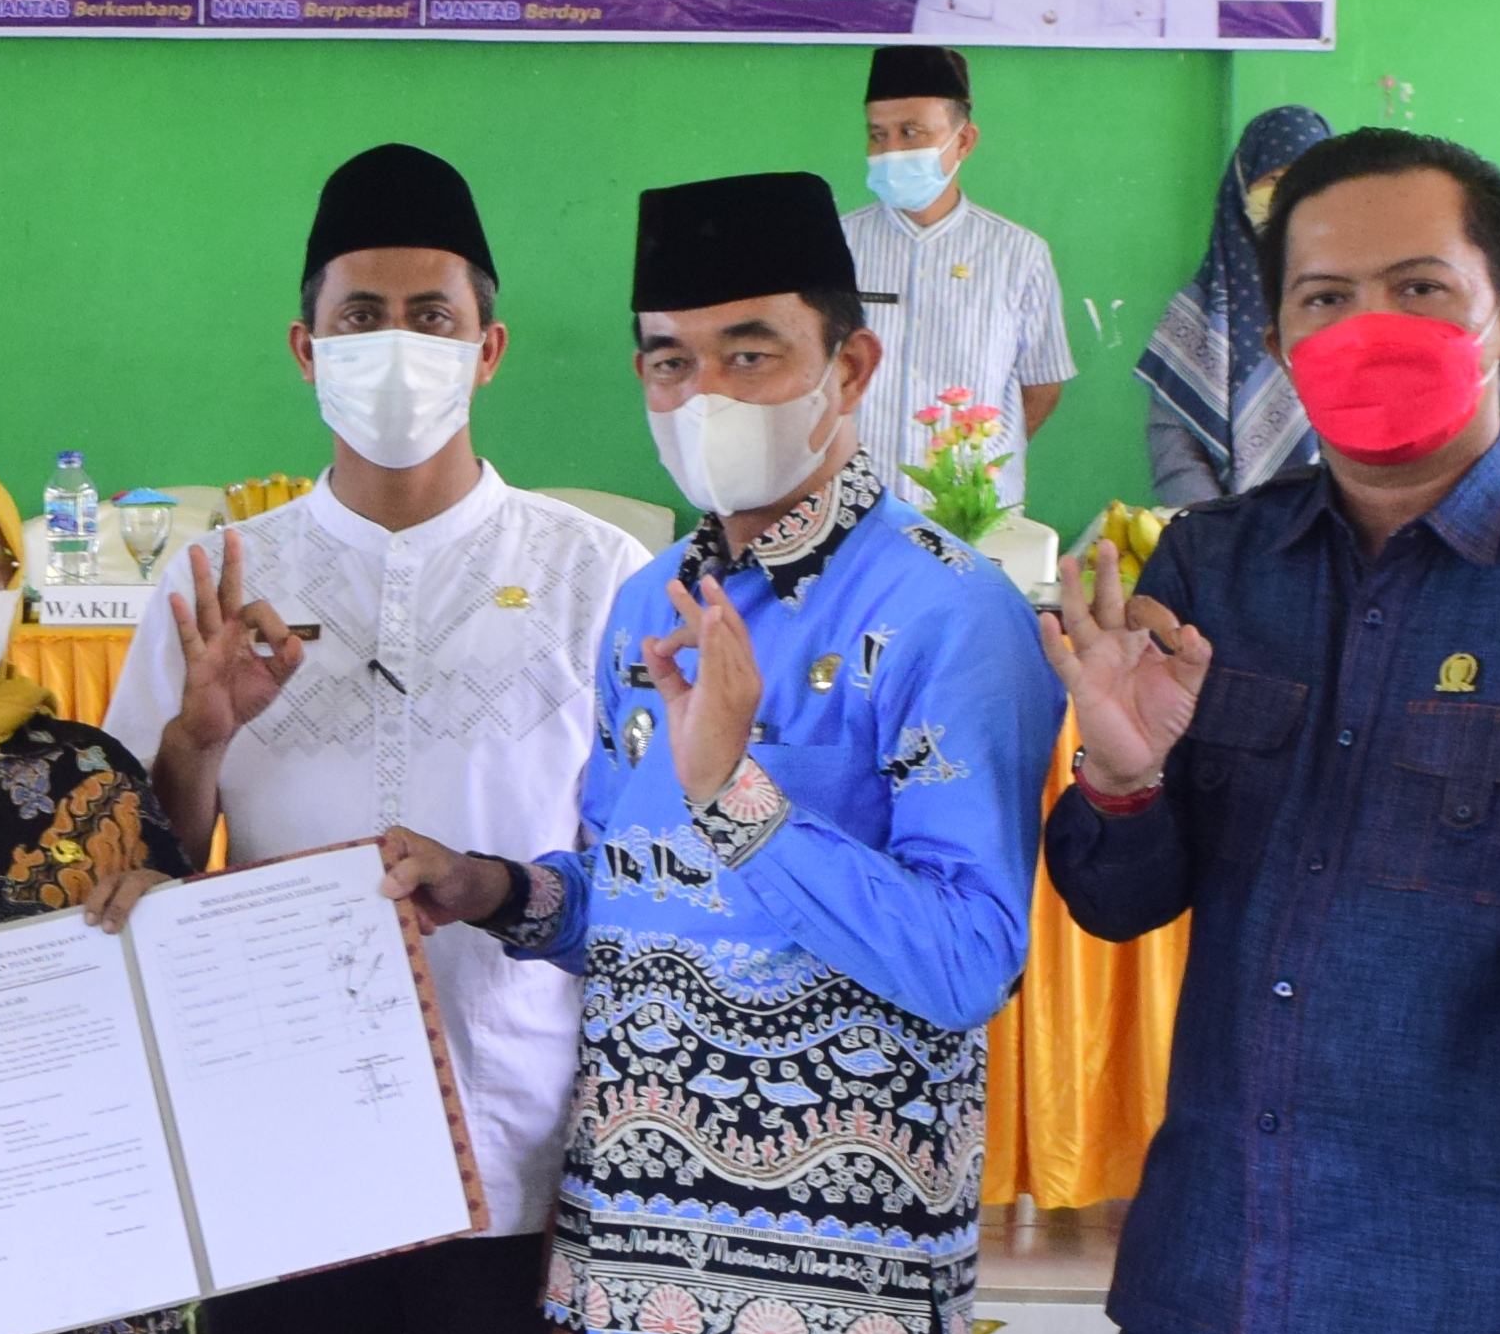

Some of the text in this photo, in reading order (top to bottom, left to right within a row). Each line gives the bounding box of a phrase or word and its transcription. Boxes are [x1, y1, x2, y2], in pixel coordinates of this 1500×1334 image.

[73, 0, 193, 21] Berkembang
[303, 1, 412, 22] Berprestasi
[429, 0, 602, 23] MANTAB Berdaya
[45, 600, 138, 619] WAKIL
